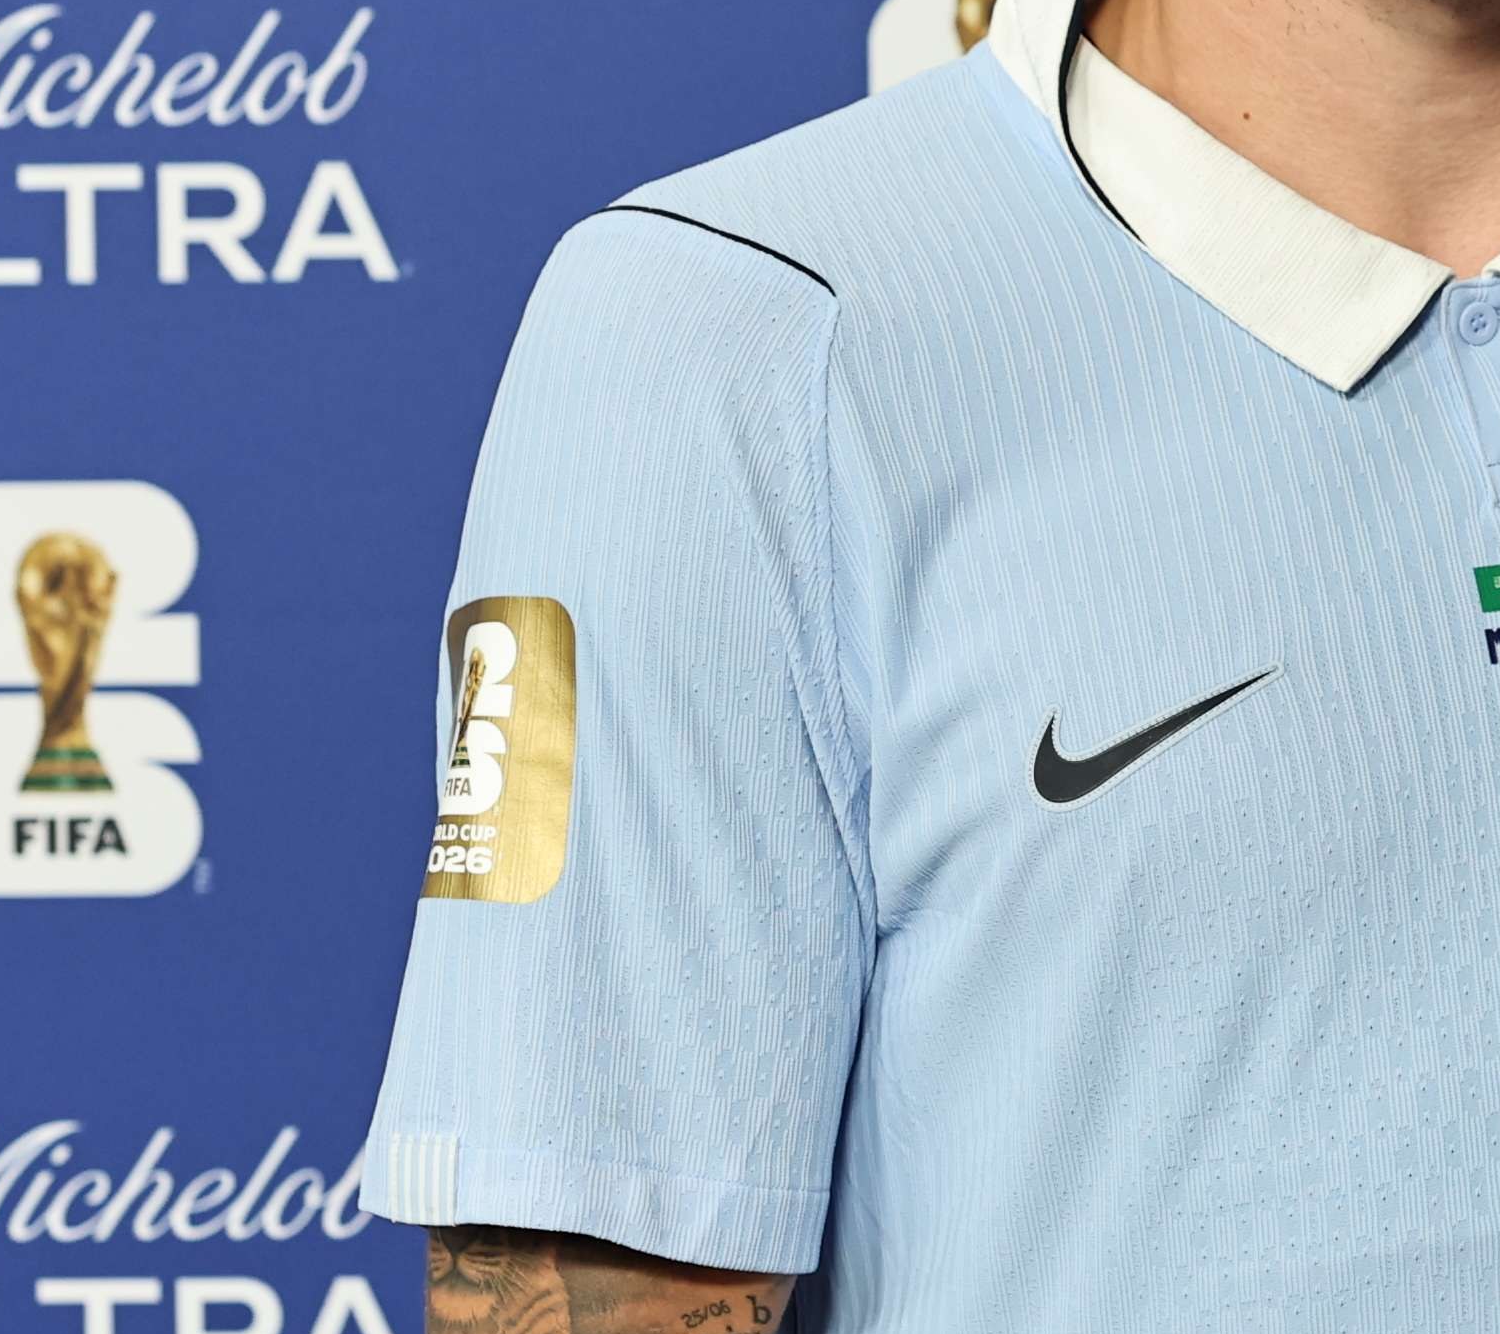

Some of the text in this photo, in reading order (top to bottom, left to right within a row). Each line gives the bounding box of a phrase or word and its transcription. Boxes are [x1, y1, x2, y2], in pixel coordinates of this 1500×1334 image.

[13, 817, 127, 855] FIFA
[460, 823, 497, 842] CUP
[428, 845, 493, 875] 026
